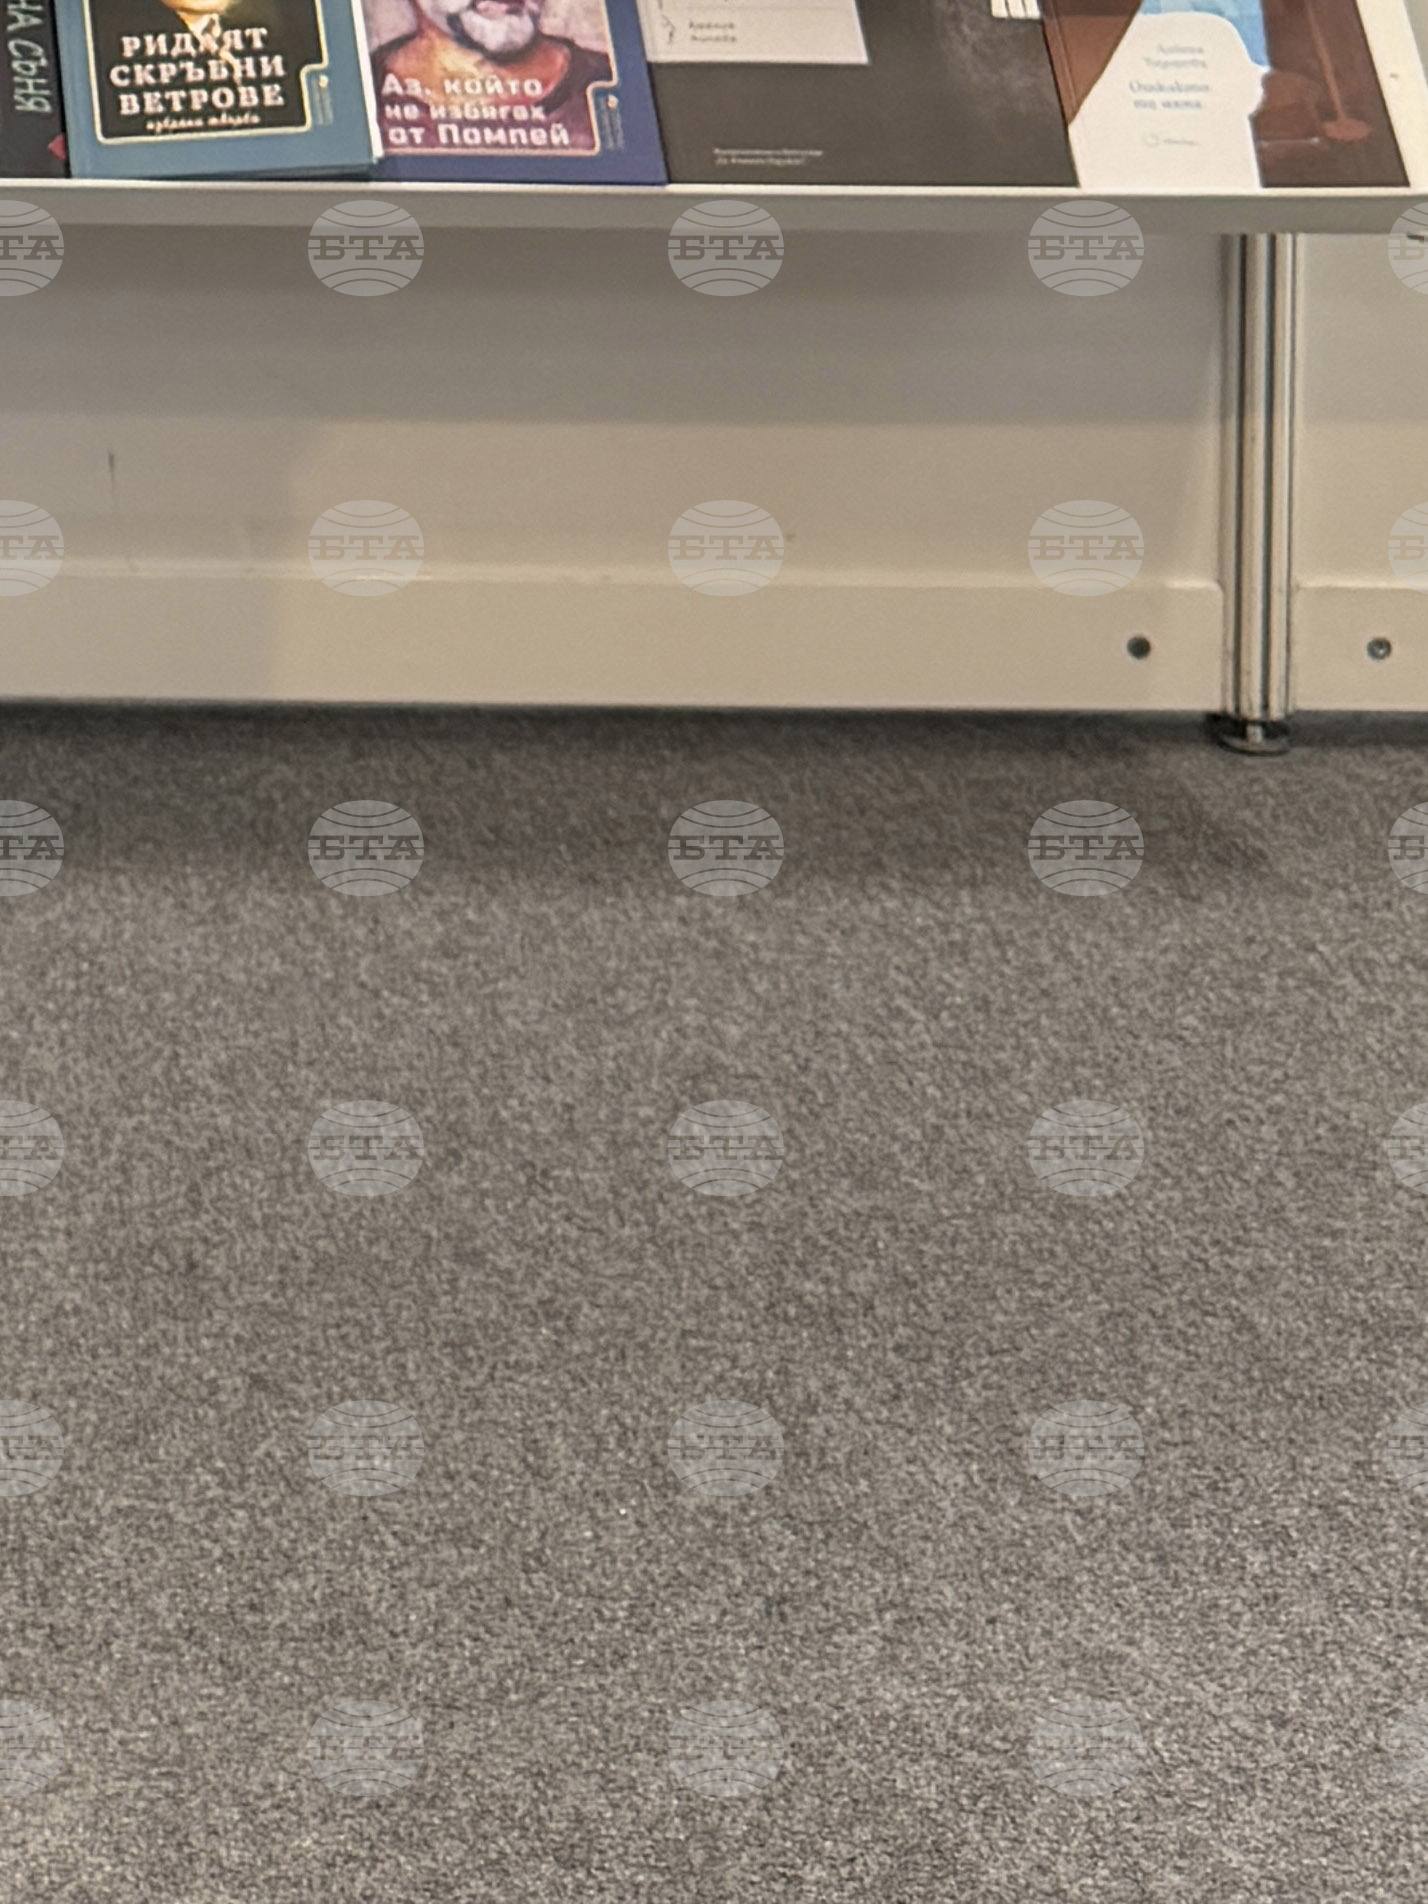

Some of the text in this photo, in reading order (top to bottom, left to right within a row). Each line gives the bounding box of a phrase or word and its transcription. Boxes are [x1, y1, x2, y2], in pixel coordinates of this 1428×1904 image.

[121, 26, 269, 58] РИДАЯТ
[109, 56, 287, 87] СКРЪБНИ
[118, 84, 285, 116] ВЕТРОВЕ
[388, 121, 571, 146] от Помпей
